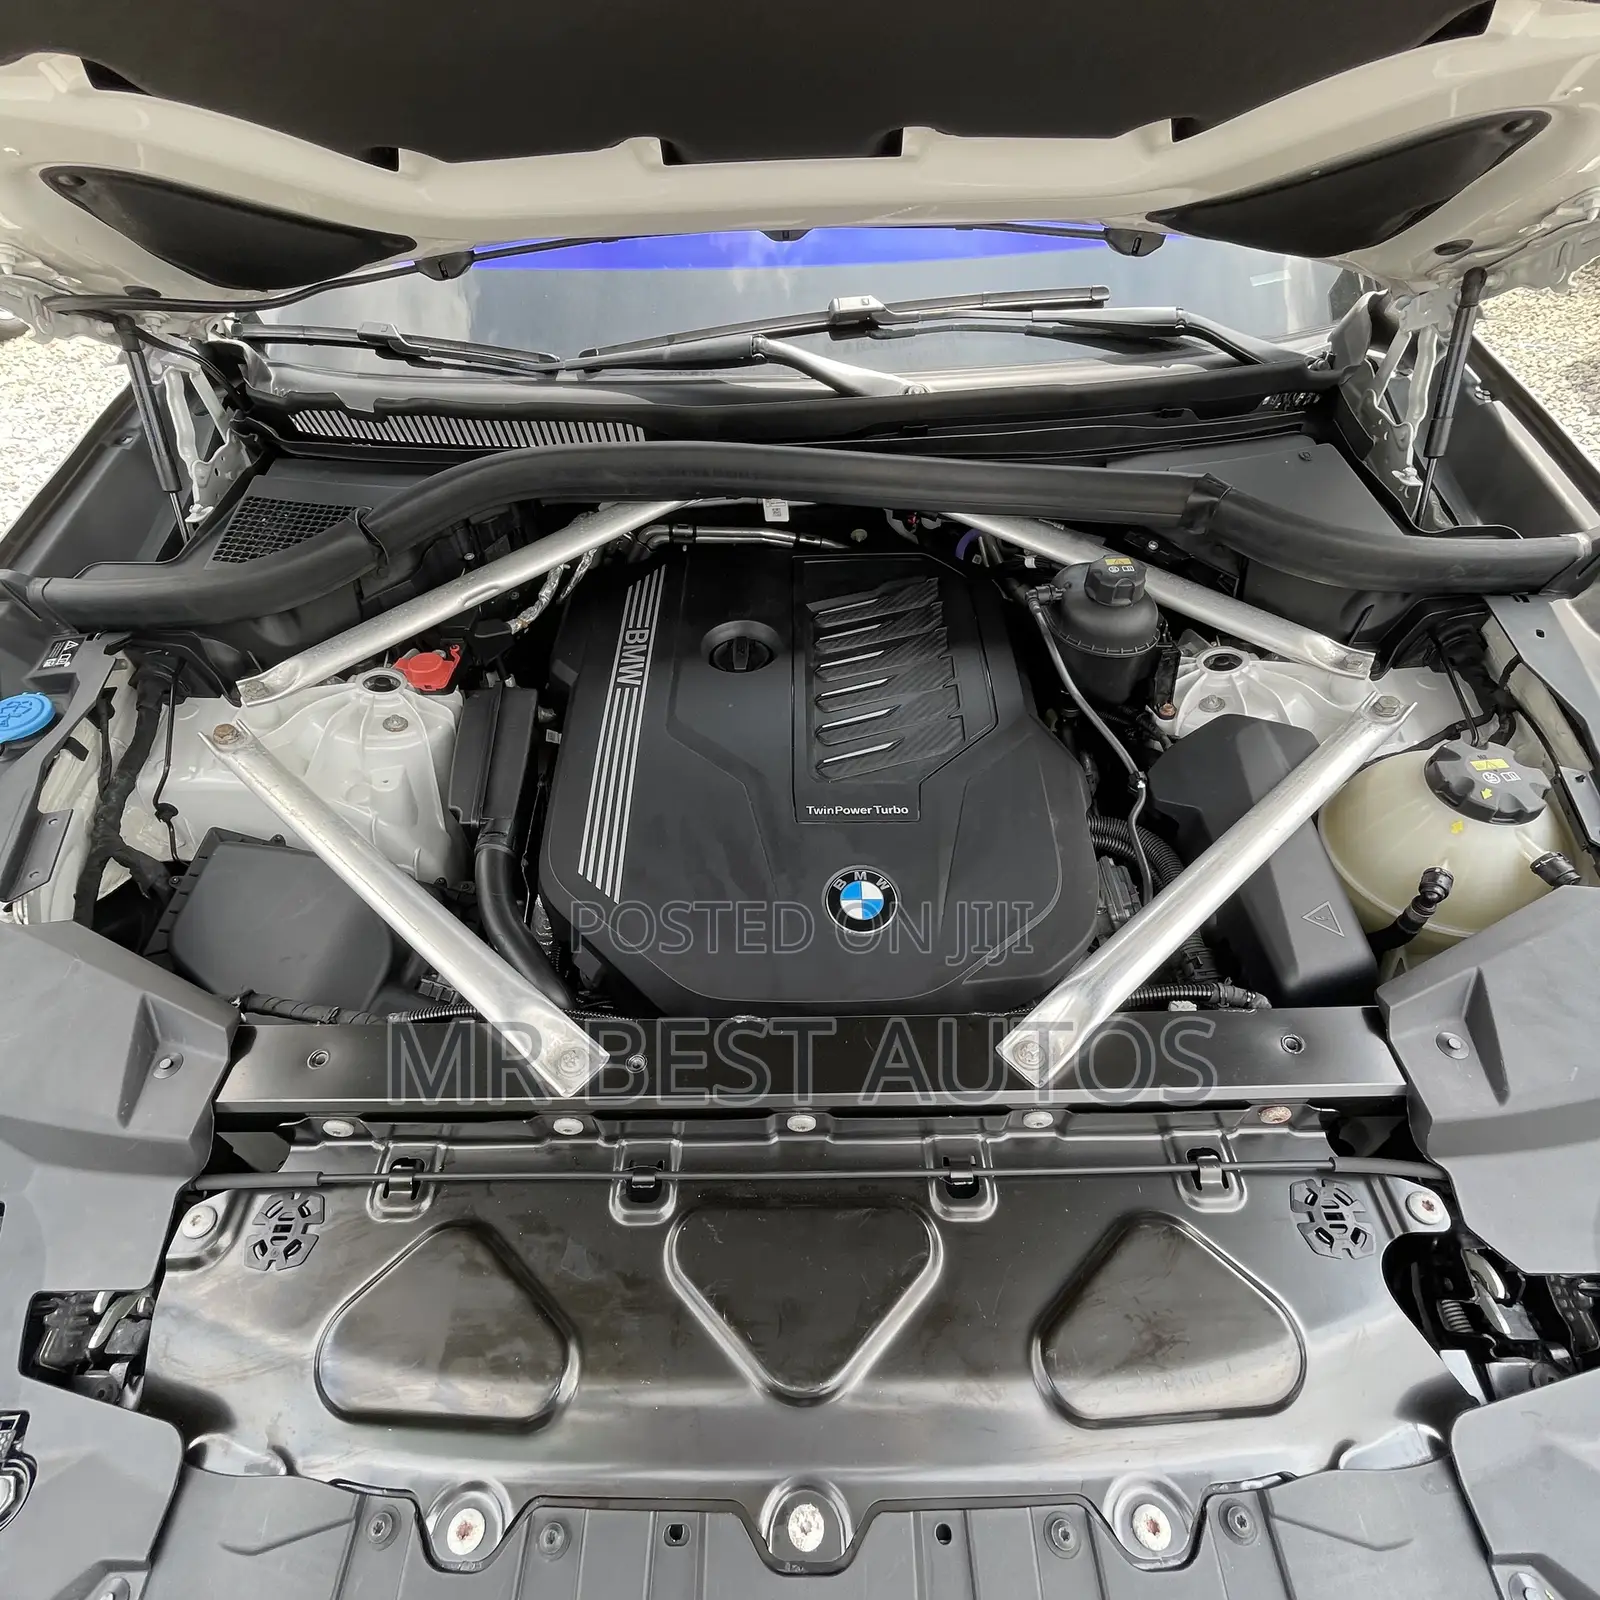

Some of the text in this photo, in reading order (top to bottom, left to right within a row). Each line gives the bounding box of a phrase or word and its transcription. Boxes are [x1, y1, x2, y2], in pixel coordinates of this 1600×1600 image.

[617, 629, 650, 686] BMW
[873, 805, 909, 816] Turbo
[833, 871, 891, 891] BMW
